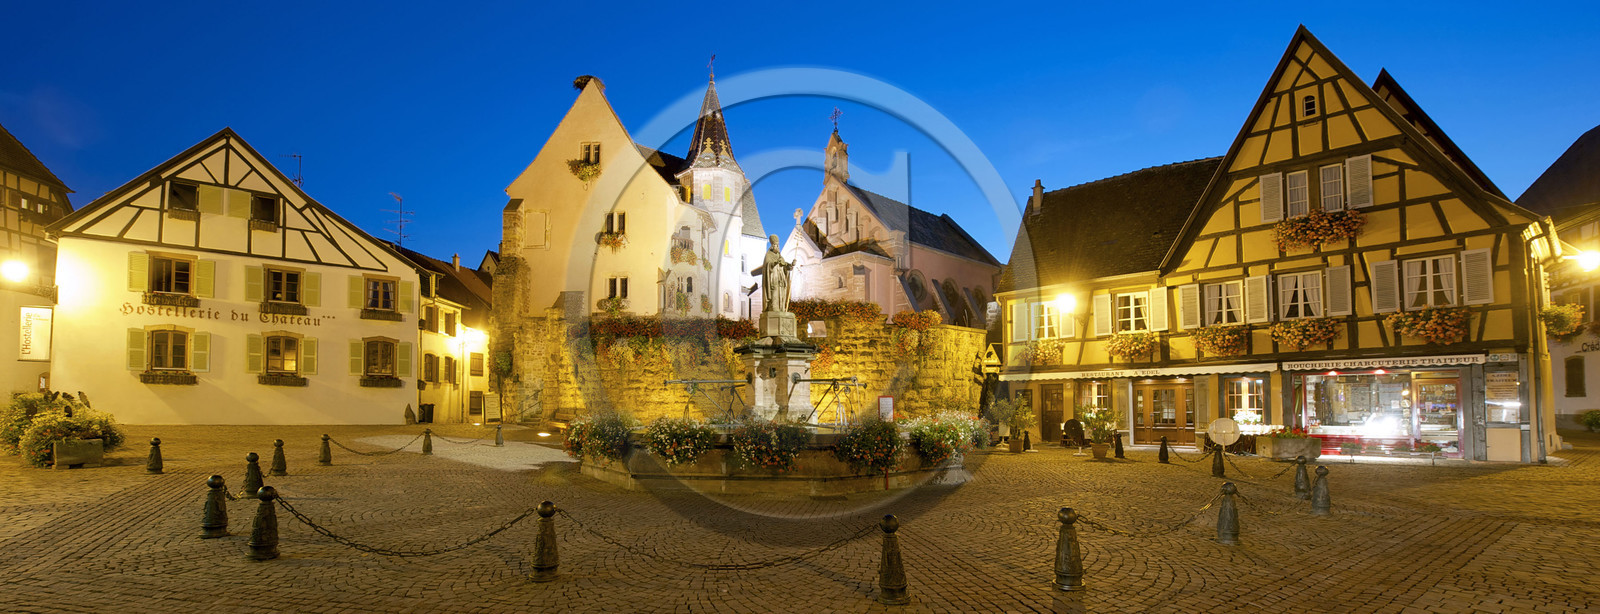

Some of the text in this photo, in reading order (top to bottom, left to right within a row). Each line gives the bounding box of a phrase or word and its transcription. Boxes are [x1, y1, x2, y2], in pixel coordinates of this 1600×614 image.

[119, 301, 220, 320] Hostellerie
[231, 309, 249, 322] du
[22, 312, 33, 355] L'Hostellerie
[1287, 357, 1479, 369] BOUCHERIE CHARCUTERIE TRAITEUR
